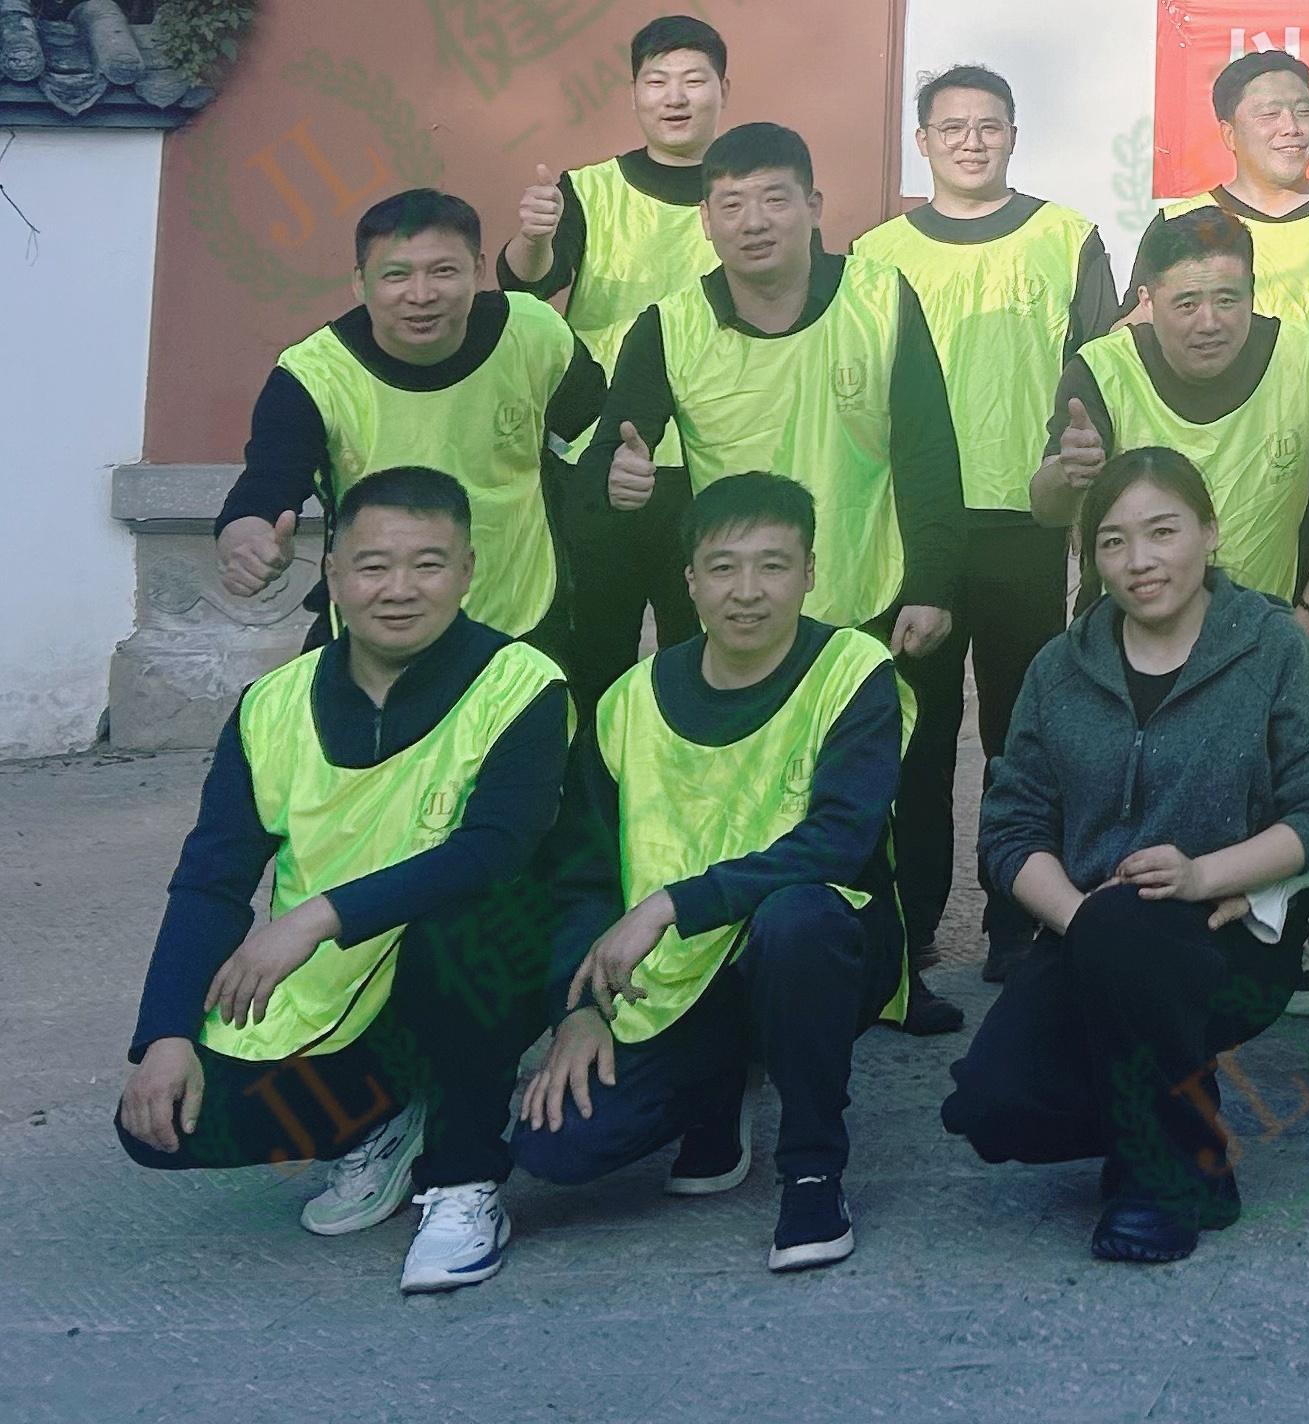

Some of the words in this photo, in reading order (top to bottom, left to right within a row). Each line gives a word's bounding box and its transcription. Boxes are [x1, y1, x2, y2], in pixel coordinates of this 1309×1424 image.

[837, 367, 858, 387] JL
[1275, 436, 1295, 457] JL
[787, 758, 811, 782] JL
[423, 791, 452, 816] JL
